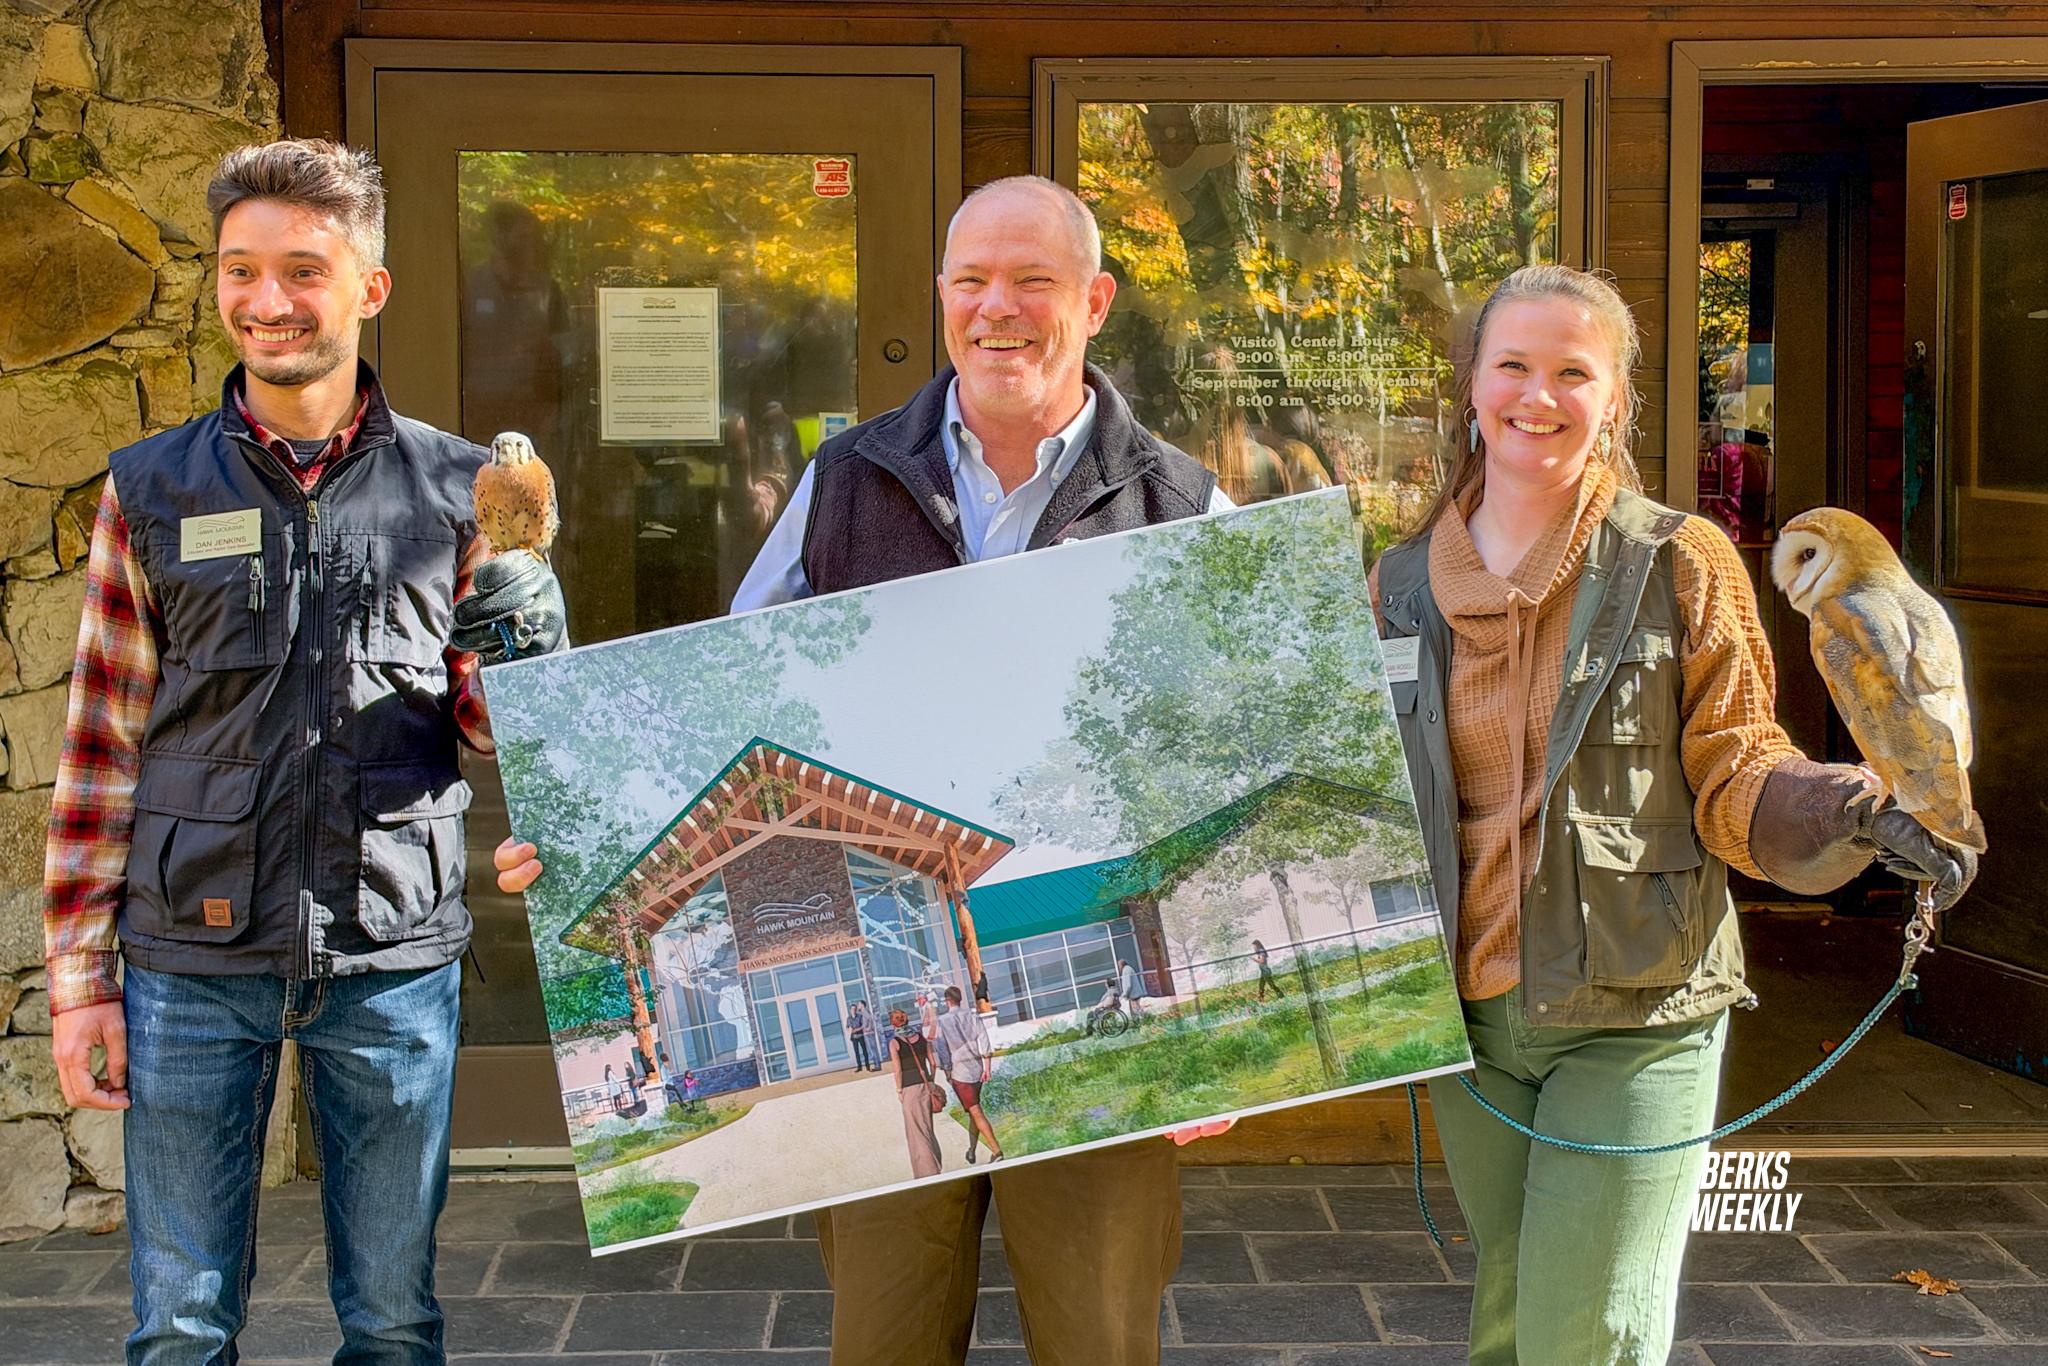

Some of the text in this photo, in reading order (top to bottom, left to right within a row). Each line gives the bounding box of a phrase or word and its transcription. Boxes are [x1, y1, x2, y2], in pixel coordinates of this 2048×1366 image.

[1351, 336, 1399, 347] Hours
[1236, 351, 1274, 363] 9:00
[1279, 353, 1304, 363] am
[1327, 351, 1364, 363] 5:00
[1370, 352, 1395, 365] pm
[1193, 375, 1438, 392] September through Noember
[1235, 395, 1274, 407] 8:00
[1279, 397, 1304, 406] am
[1327, 393, 1364, 406] 5:00
[1370, 396, 1395, 408] pm
[214, 536, 247, 546] JENKINS
[756, 912, 835, 935] HAWK MOUNTAIN
[743, 939, 860, 971] HAWK MOUNTAIN SANCTUARY
